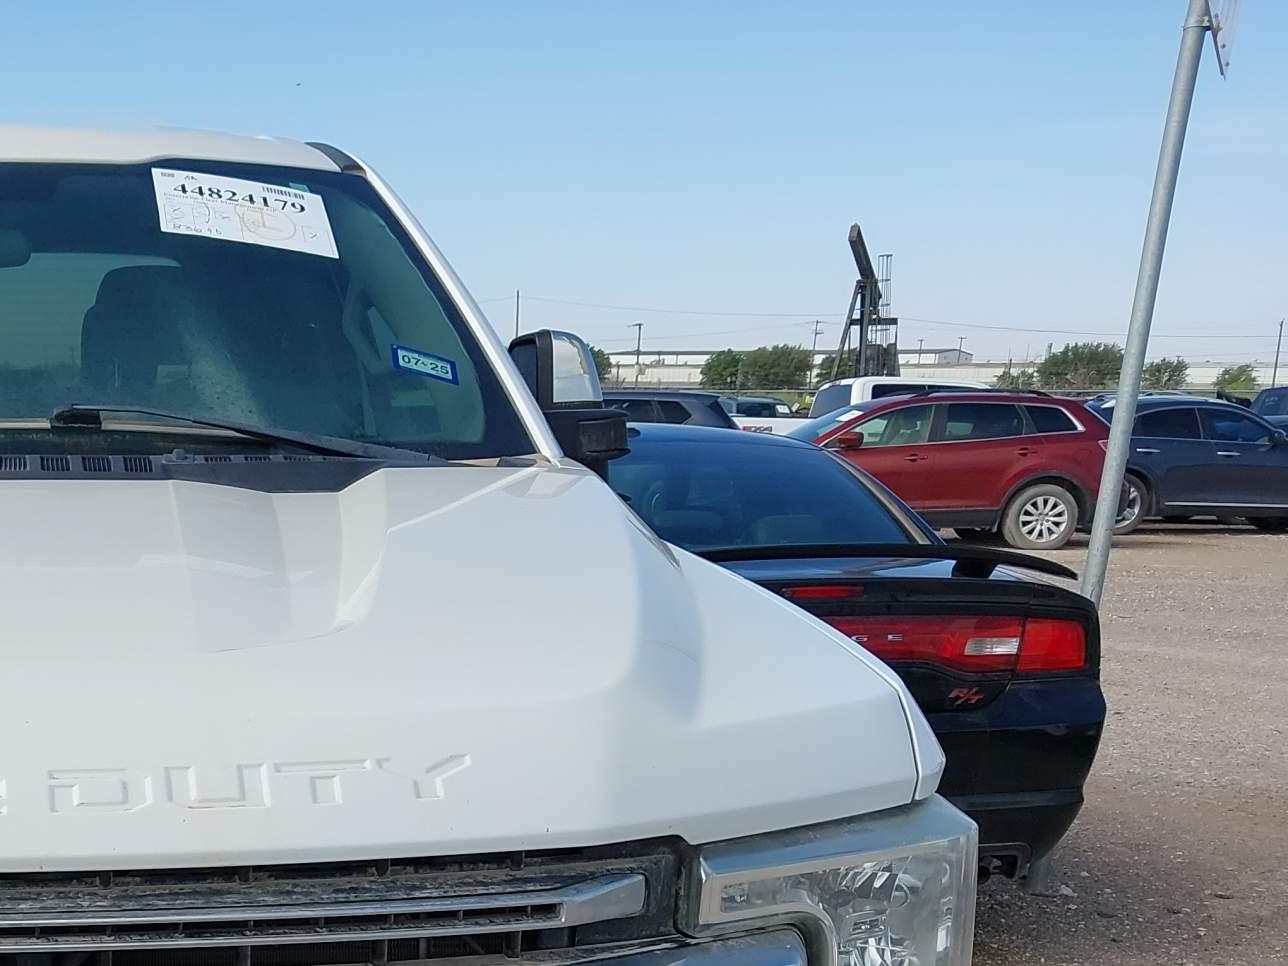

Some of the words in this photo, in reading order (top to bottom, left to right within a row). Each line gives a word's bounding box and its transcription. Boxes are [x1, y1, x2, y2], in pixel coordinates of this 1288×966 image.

[173, 183, 306, 214] 44824179
[401, 354, 449, 375] 07-25
[47, 752, 473, 815] DUTY
